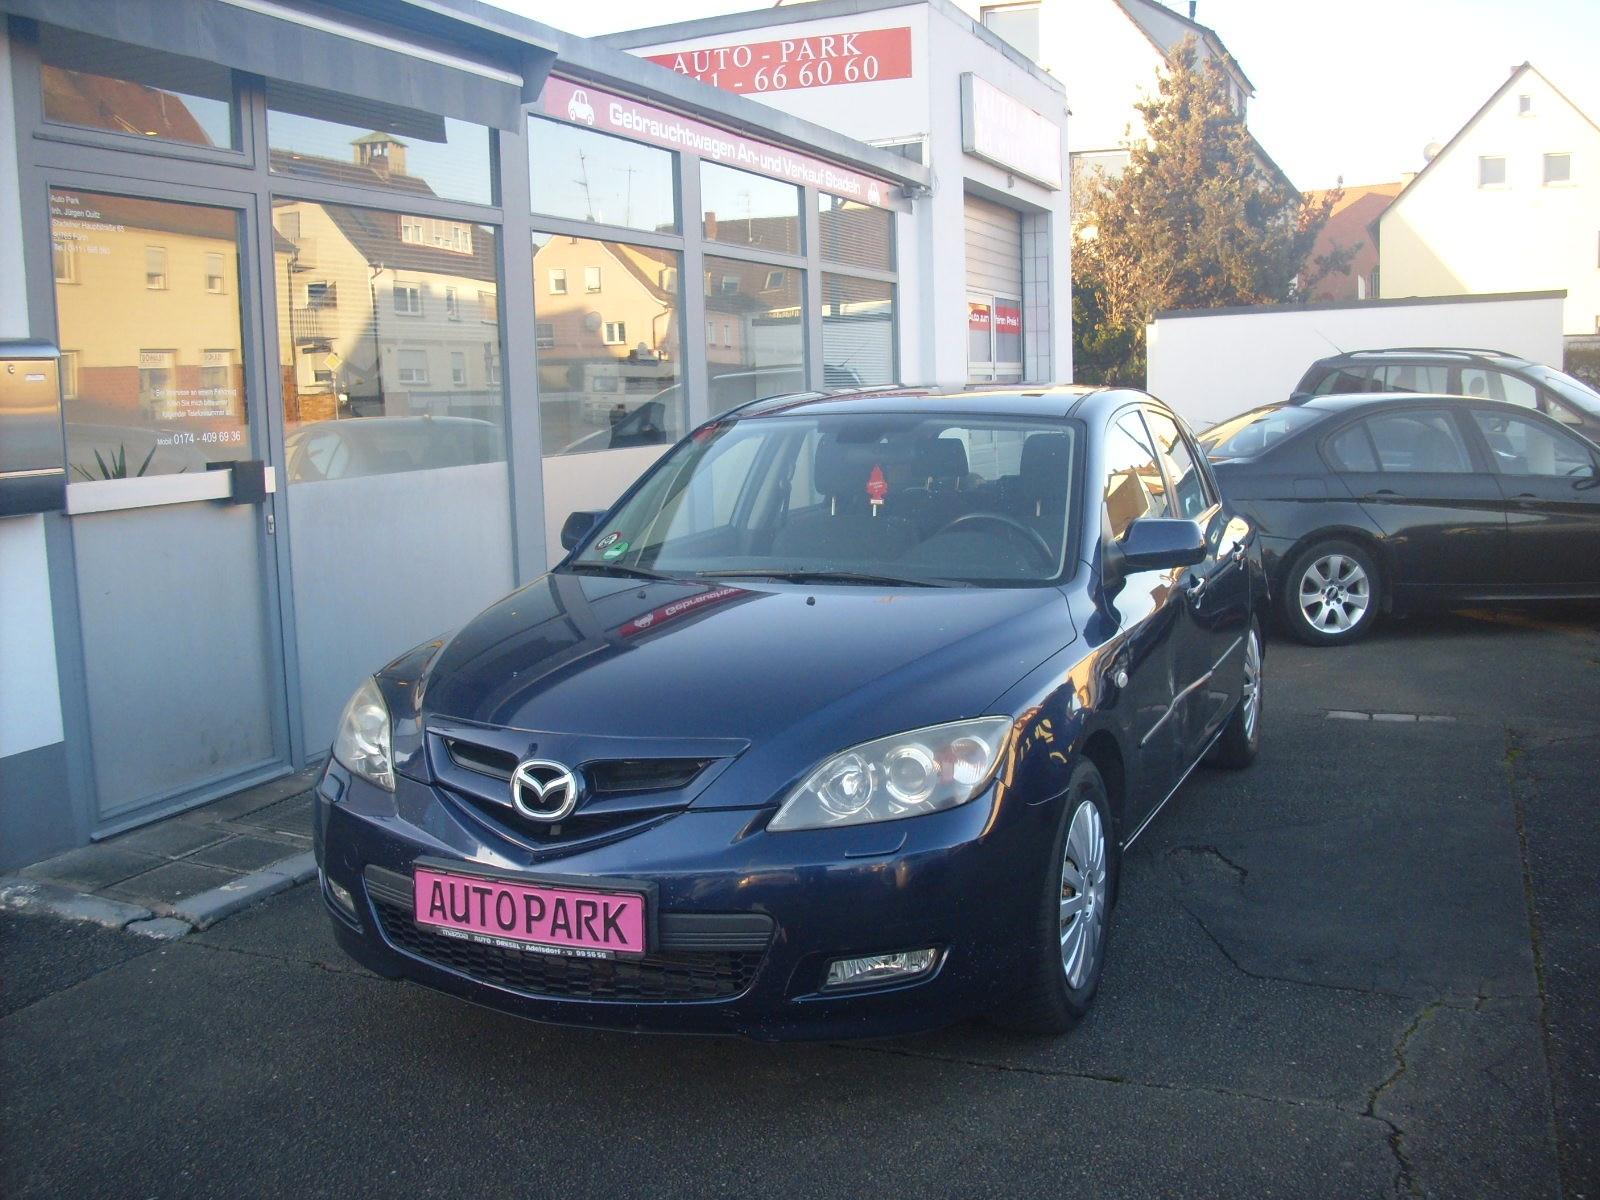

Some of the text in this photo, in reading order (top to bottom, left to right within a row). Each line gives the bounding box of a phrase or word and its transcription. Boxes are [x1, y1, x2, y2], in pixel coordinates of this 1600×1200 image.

[673, 45, 752, 75] AUTO
[780, 33, 863, 63] PARK
[754, 64, 787, 91] 66
[798, 60, 833, 87] 60
[844, 55, 879, 81] 60
[609, 102, 736, 160] Gebrauchtwagen
[782, 157, 824, 184] Verkauf
[825, 170, 861, 196] Stadeln
[66, 195, 80, 205] Park
[173, 432, 194, 445] 0174
[202, 431, 217, 443] 409
[219, 431, 230, 442] 69
[231, 430, 241, 441] 36
[474, 935, 492, 944] AUTO
[525, 944, 561, 955] Adelsdorf
